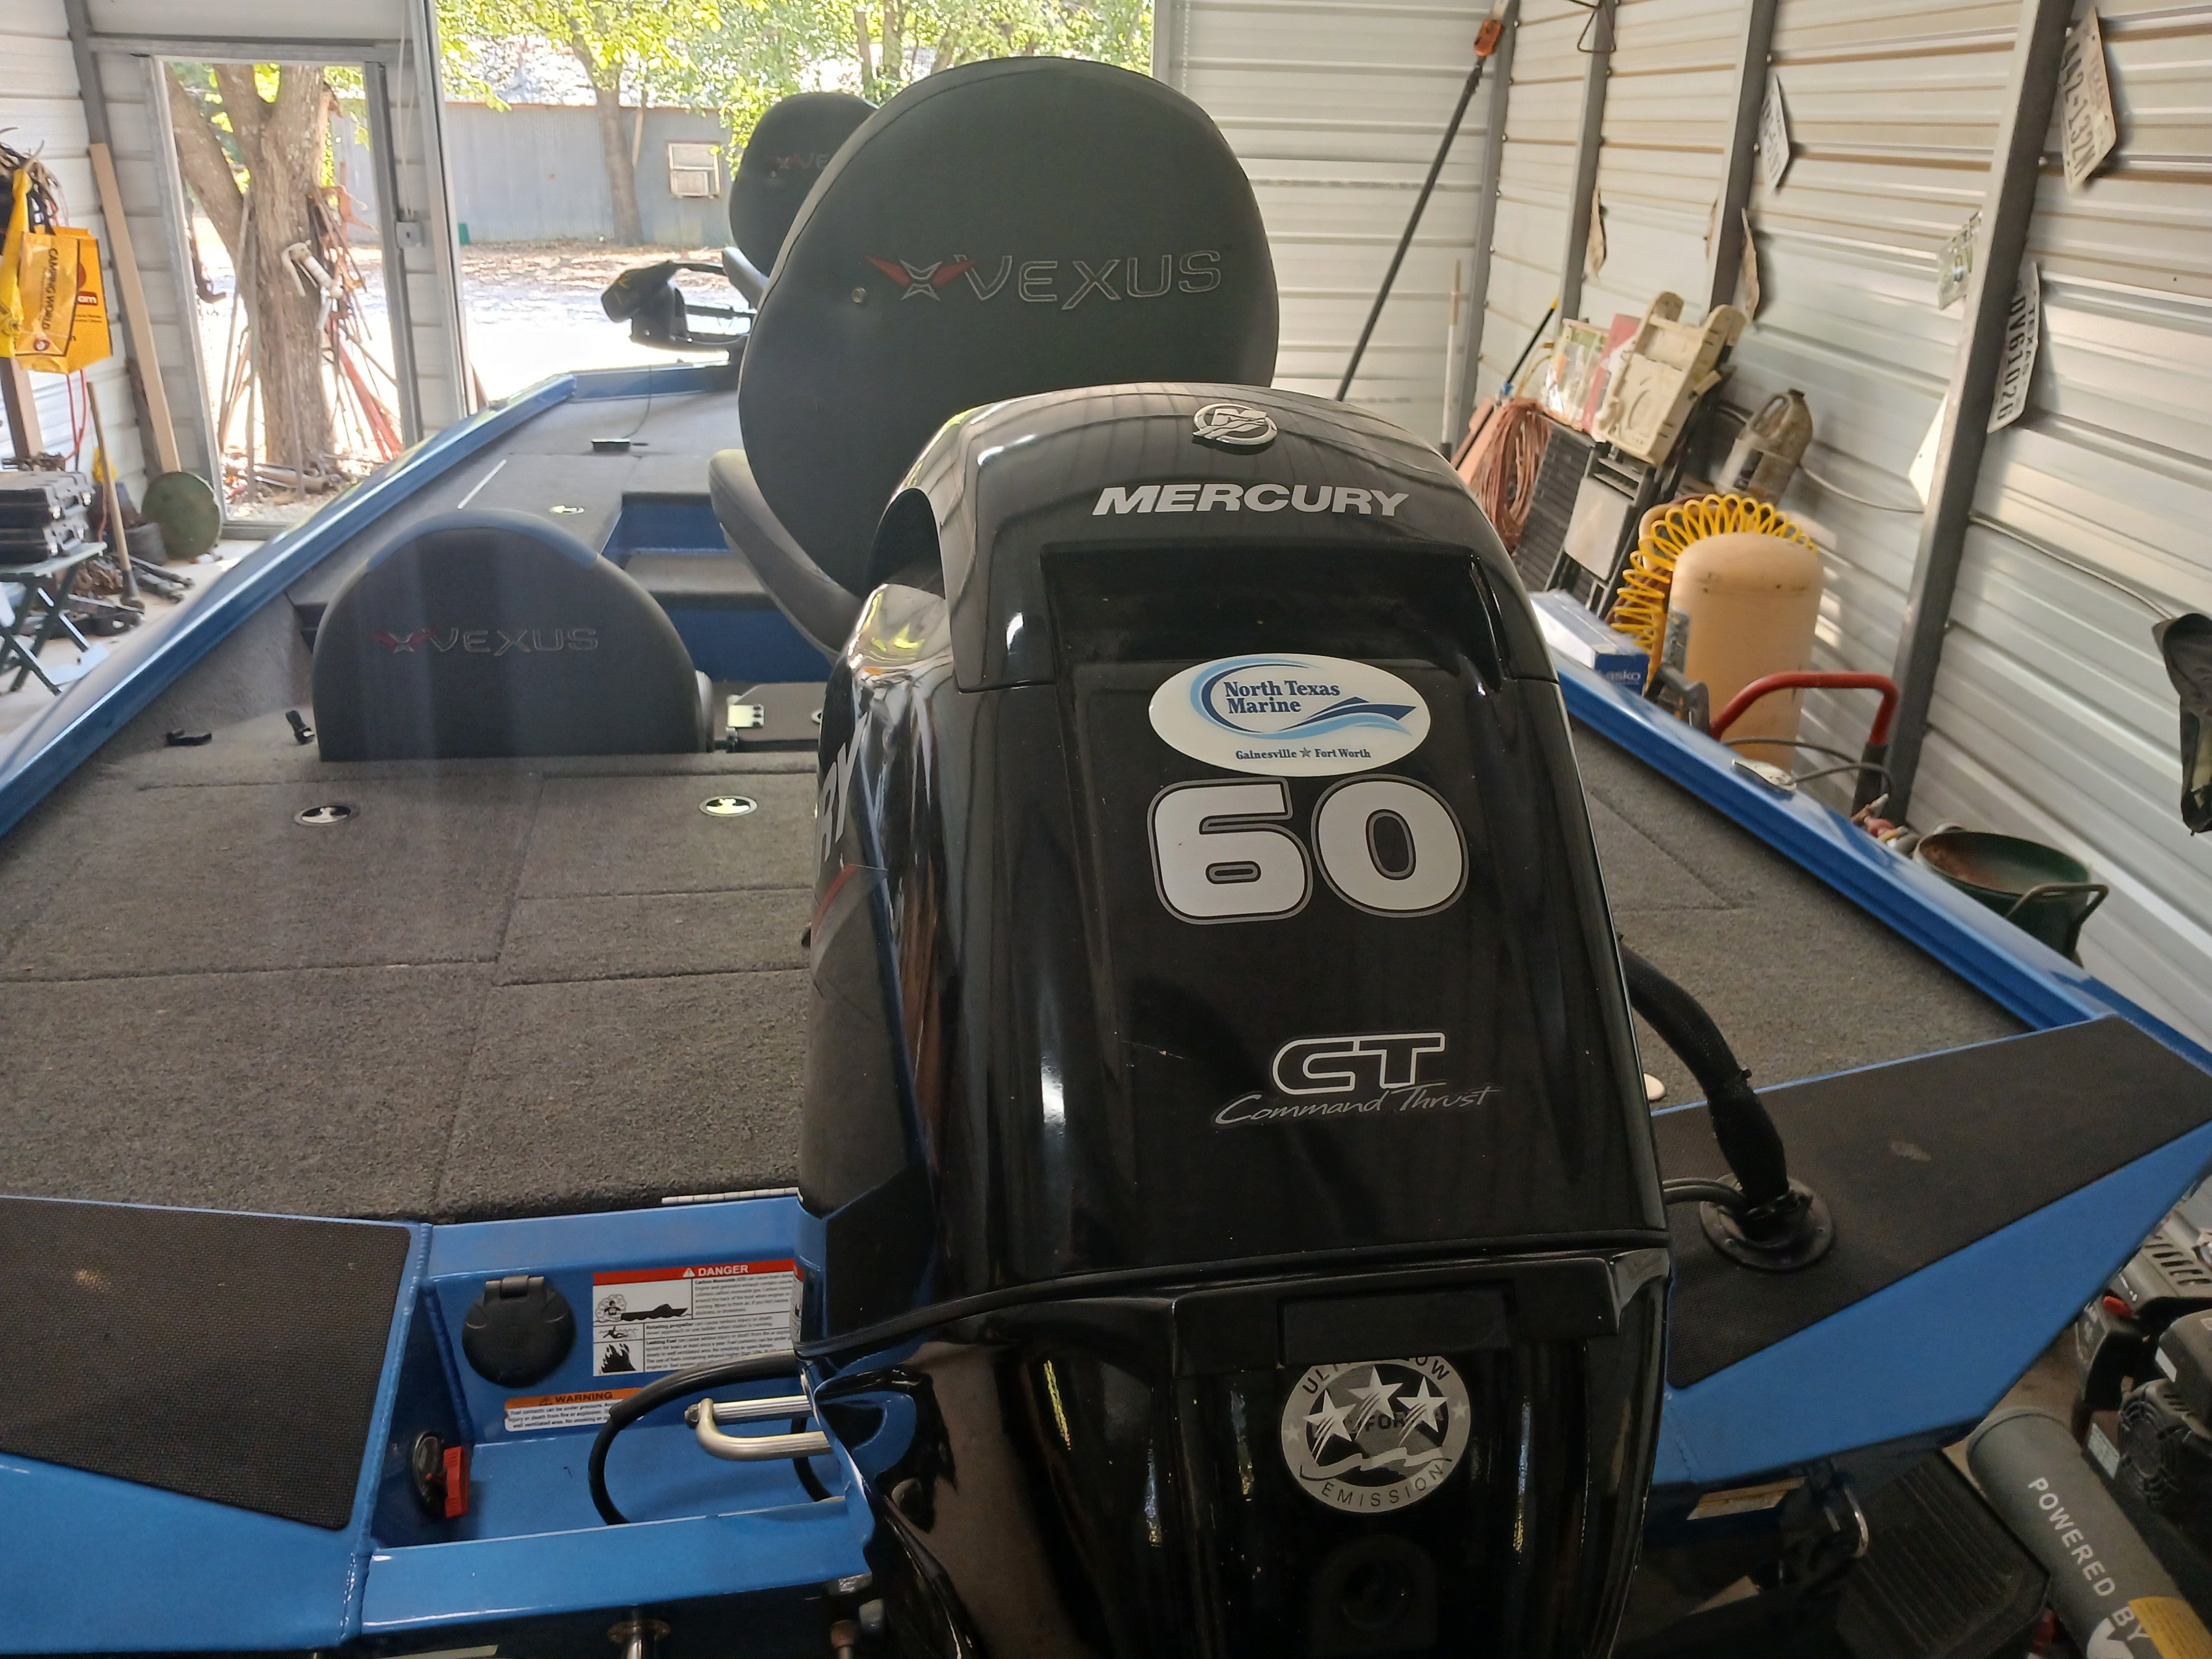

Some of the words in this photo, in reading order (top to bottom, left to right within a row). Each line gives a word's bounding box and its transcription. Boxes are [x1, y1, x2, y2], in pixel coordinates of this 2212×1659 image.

[954, 249, 1221, 311] VEXUS
[1091, 483, 1410, 517] MERCURY
[421, 627, 599, 657] VEXUS
[1223, 680, 1281, 697] North
[1284, 680, 1340, 697] Texas
[1226, 697, 1301, 714] Marine
[1236, 748, 1297, 760] Gainesville
[1315, 748, 1338, 758] Fort
[1339, 748, 1371, 758] Worth
[1147, 774, 1469, 925] 60
[1272, 1032, 1445, 1095] CT
[1214, 1090, 1392, 1124] Command
[1390, 1082, 1503, 1112] Thrust
[698, 1264, 749, 1277] DANGER
[555, 1392, 613, 1403] WARNING
[1322, 1464, 1446, 1507] EMISSION
[2027, 1476, 2115, 1597] POWERED
[2111, 1605, 2150, 1642] BY
